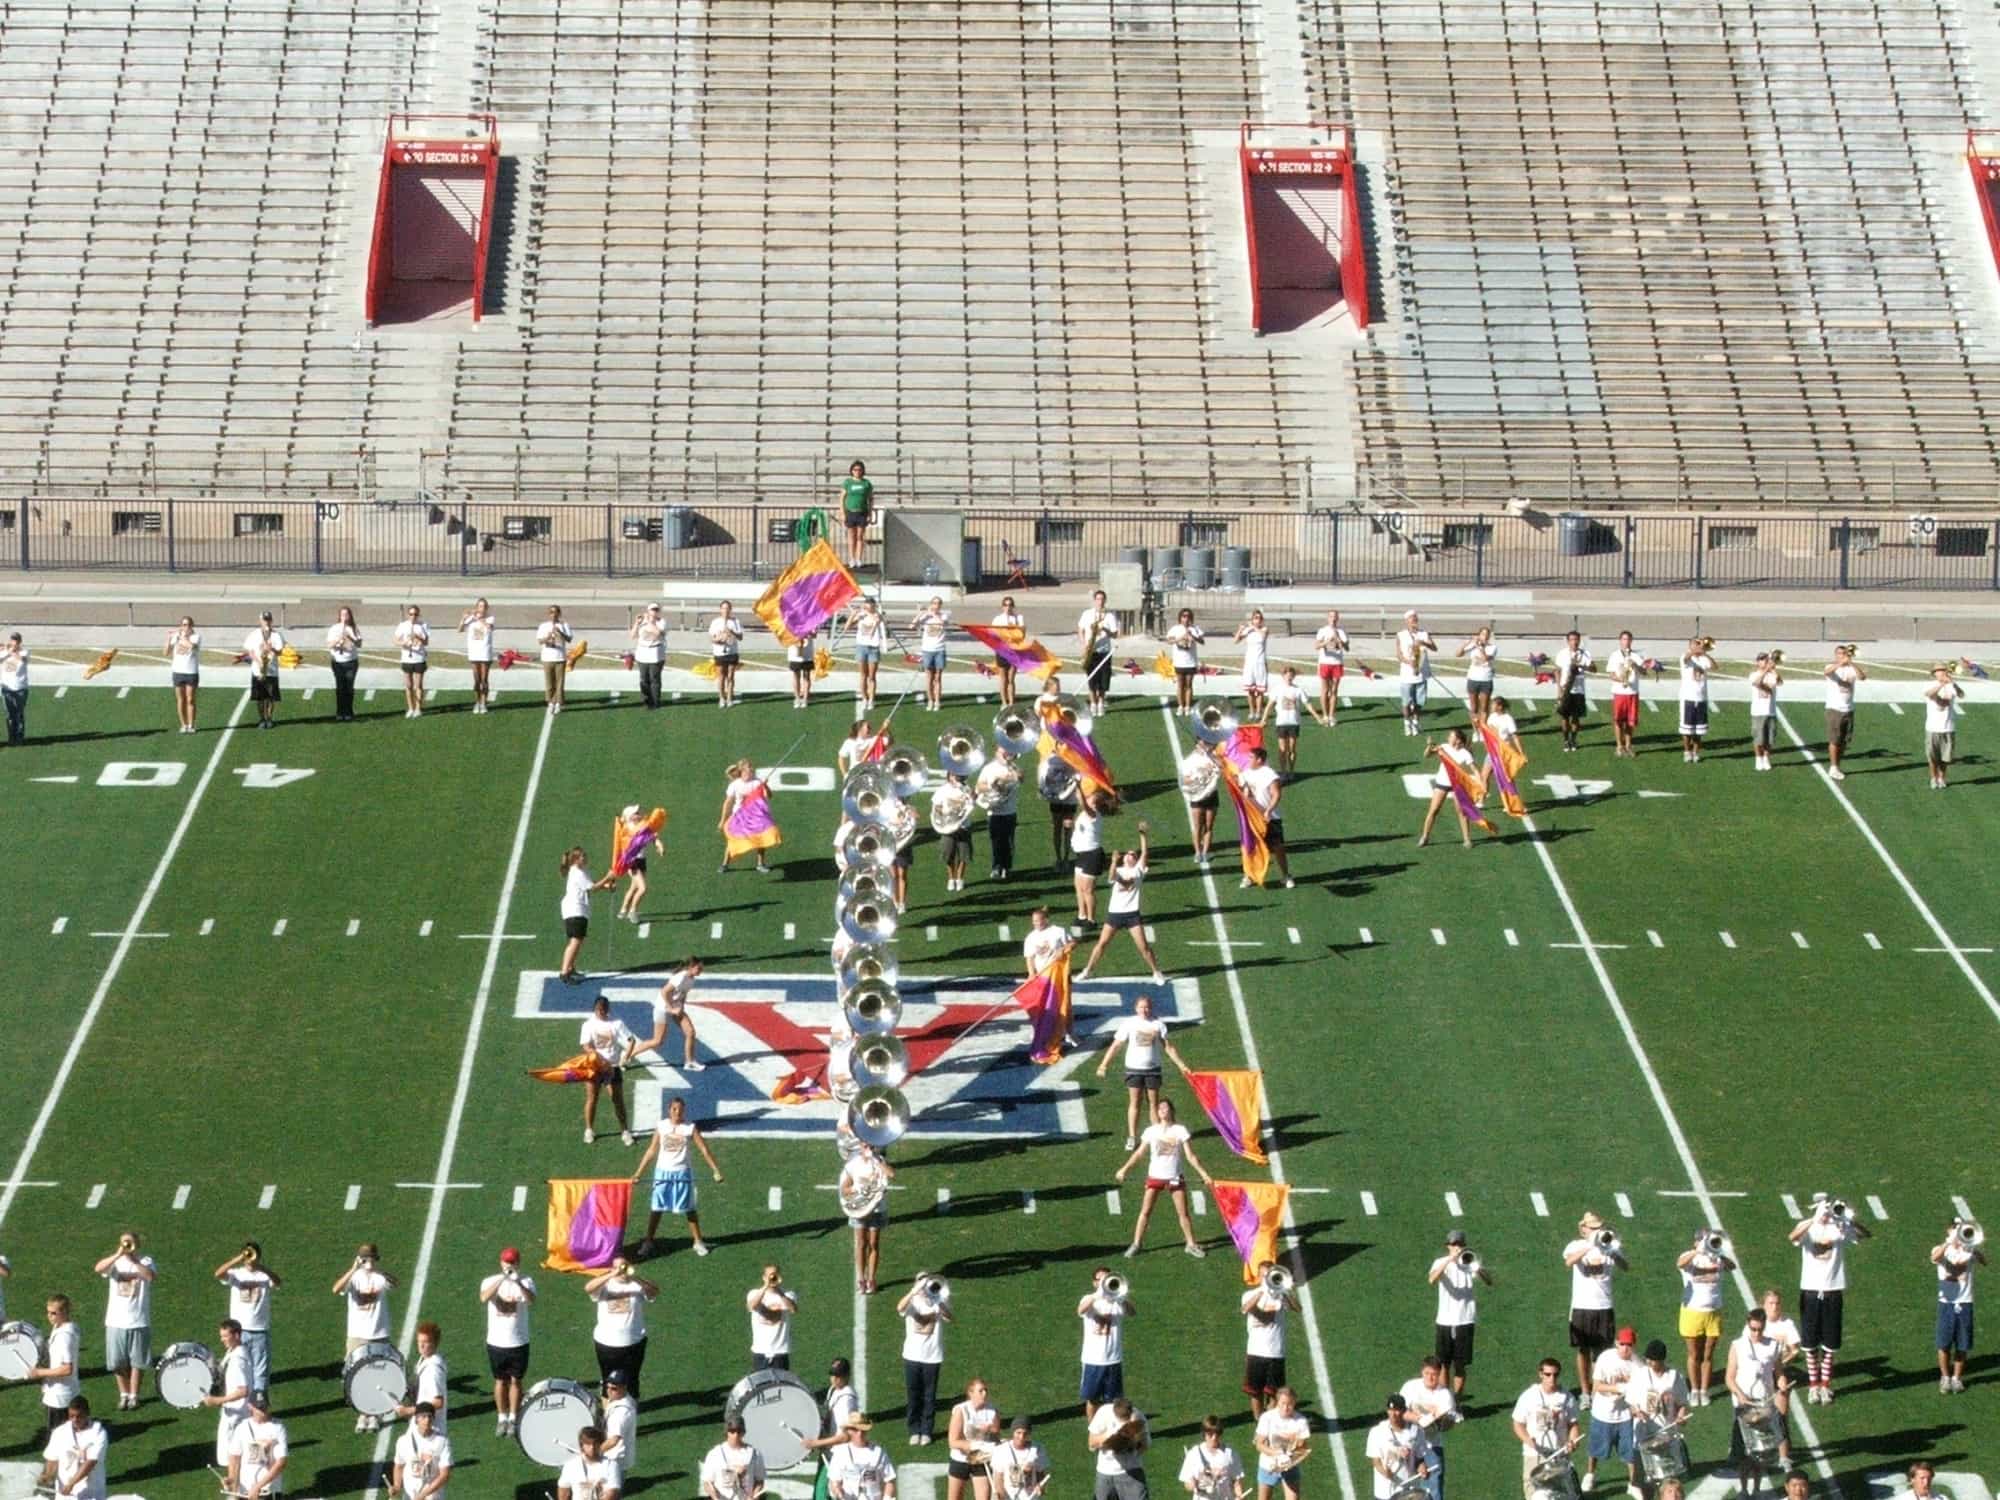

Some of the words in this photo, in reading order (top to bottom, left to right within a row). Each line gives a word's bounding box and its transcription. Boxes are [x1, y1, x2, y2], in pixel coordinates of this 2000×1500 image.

[425, 152, 459, 163] SECTION
[460, 152, 470, 163] 21
[1278, 162, 1312, 173] SECTION
[1313, 162, 1324, 173] 22
[1911, 517, 1935, 534] 30
